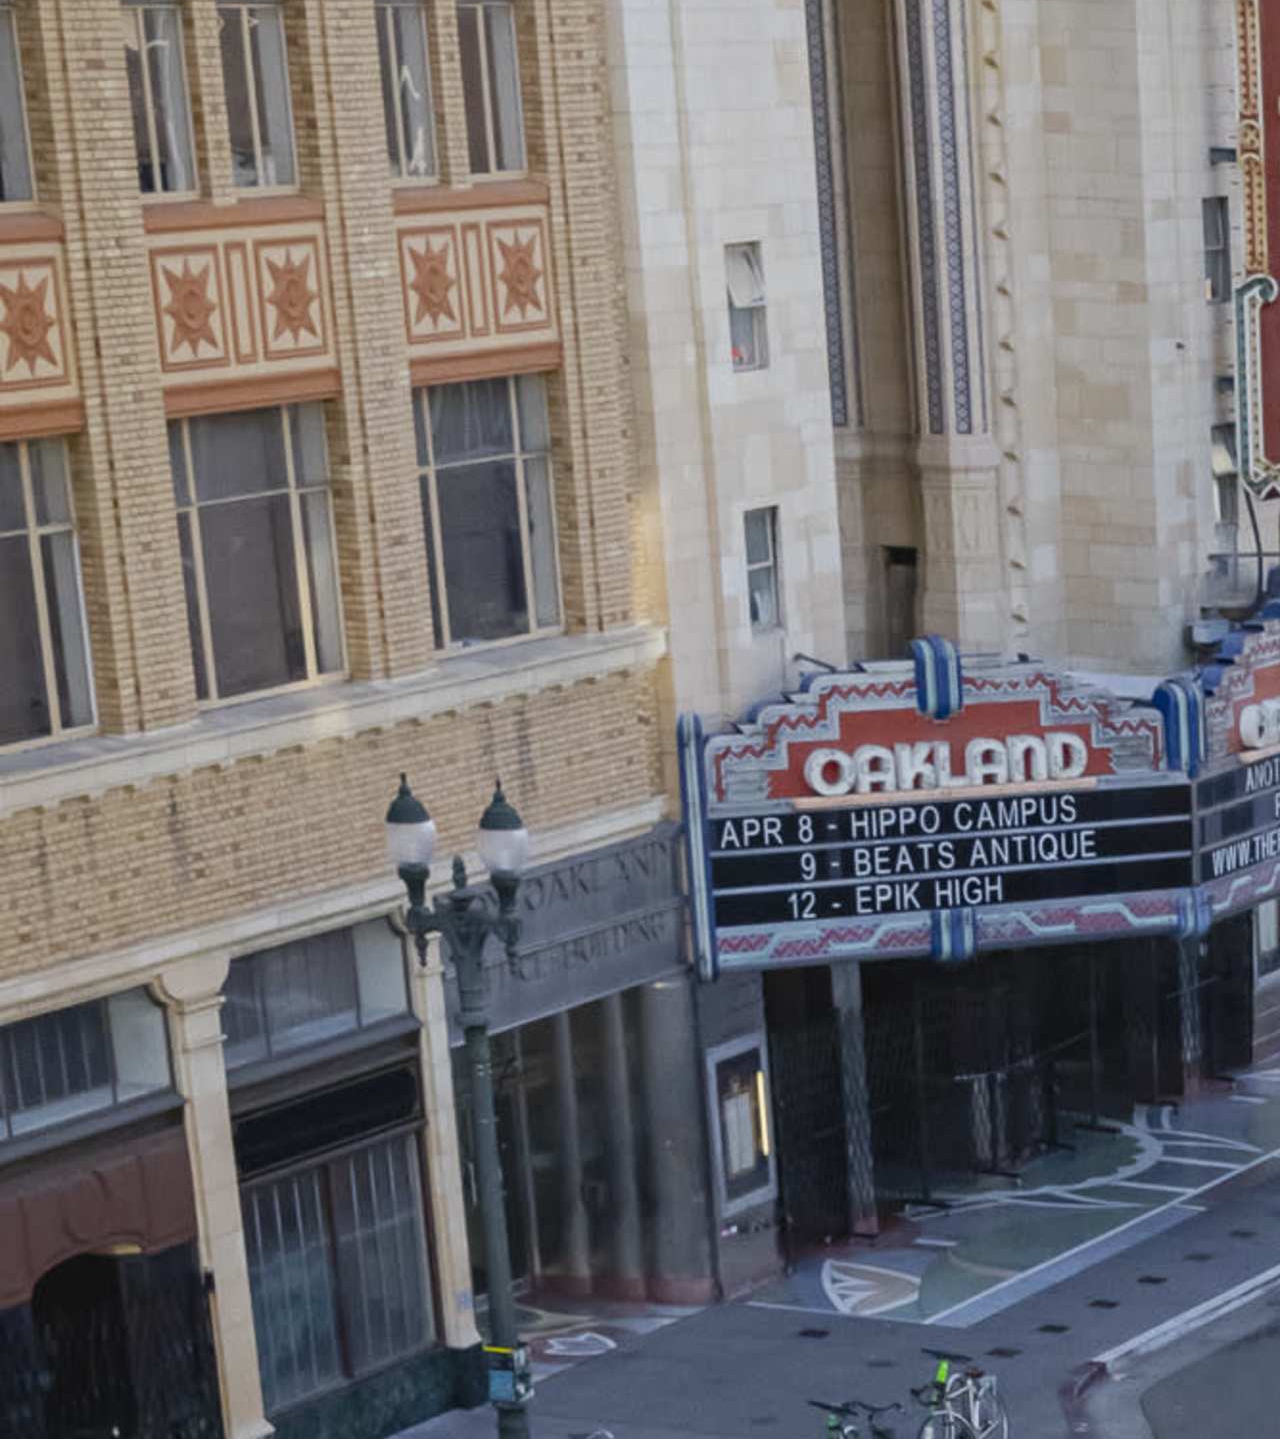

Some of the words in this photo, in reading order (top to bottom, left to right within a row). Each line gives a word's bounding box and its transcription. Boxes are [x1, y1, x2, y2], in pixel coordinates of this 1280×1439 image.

[803, 732, 1088, 797] OAKLAND
[721, 816, 783, 849] APR
[798, 815, 814, 844] 8
[850, 805, 940, 839] HIPPO
[953, 794, 1077, 831] CAMPUS
[800, 852, 817, 881] 9
[853, 840, 956, 876] BEATS
[969, 830, 1097, 868] ANTIQUE
[787, 892, 817, 919] 12
[855, 881, 921, 914] EPIK
[935, 874, 1003, 907] HIGH
